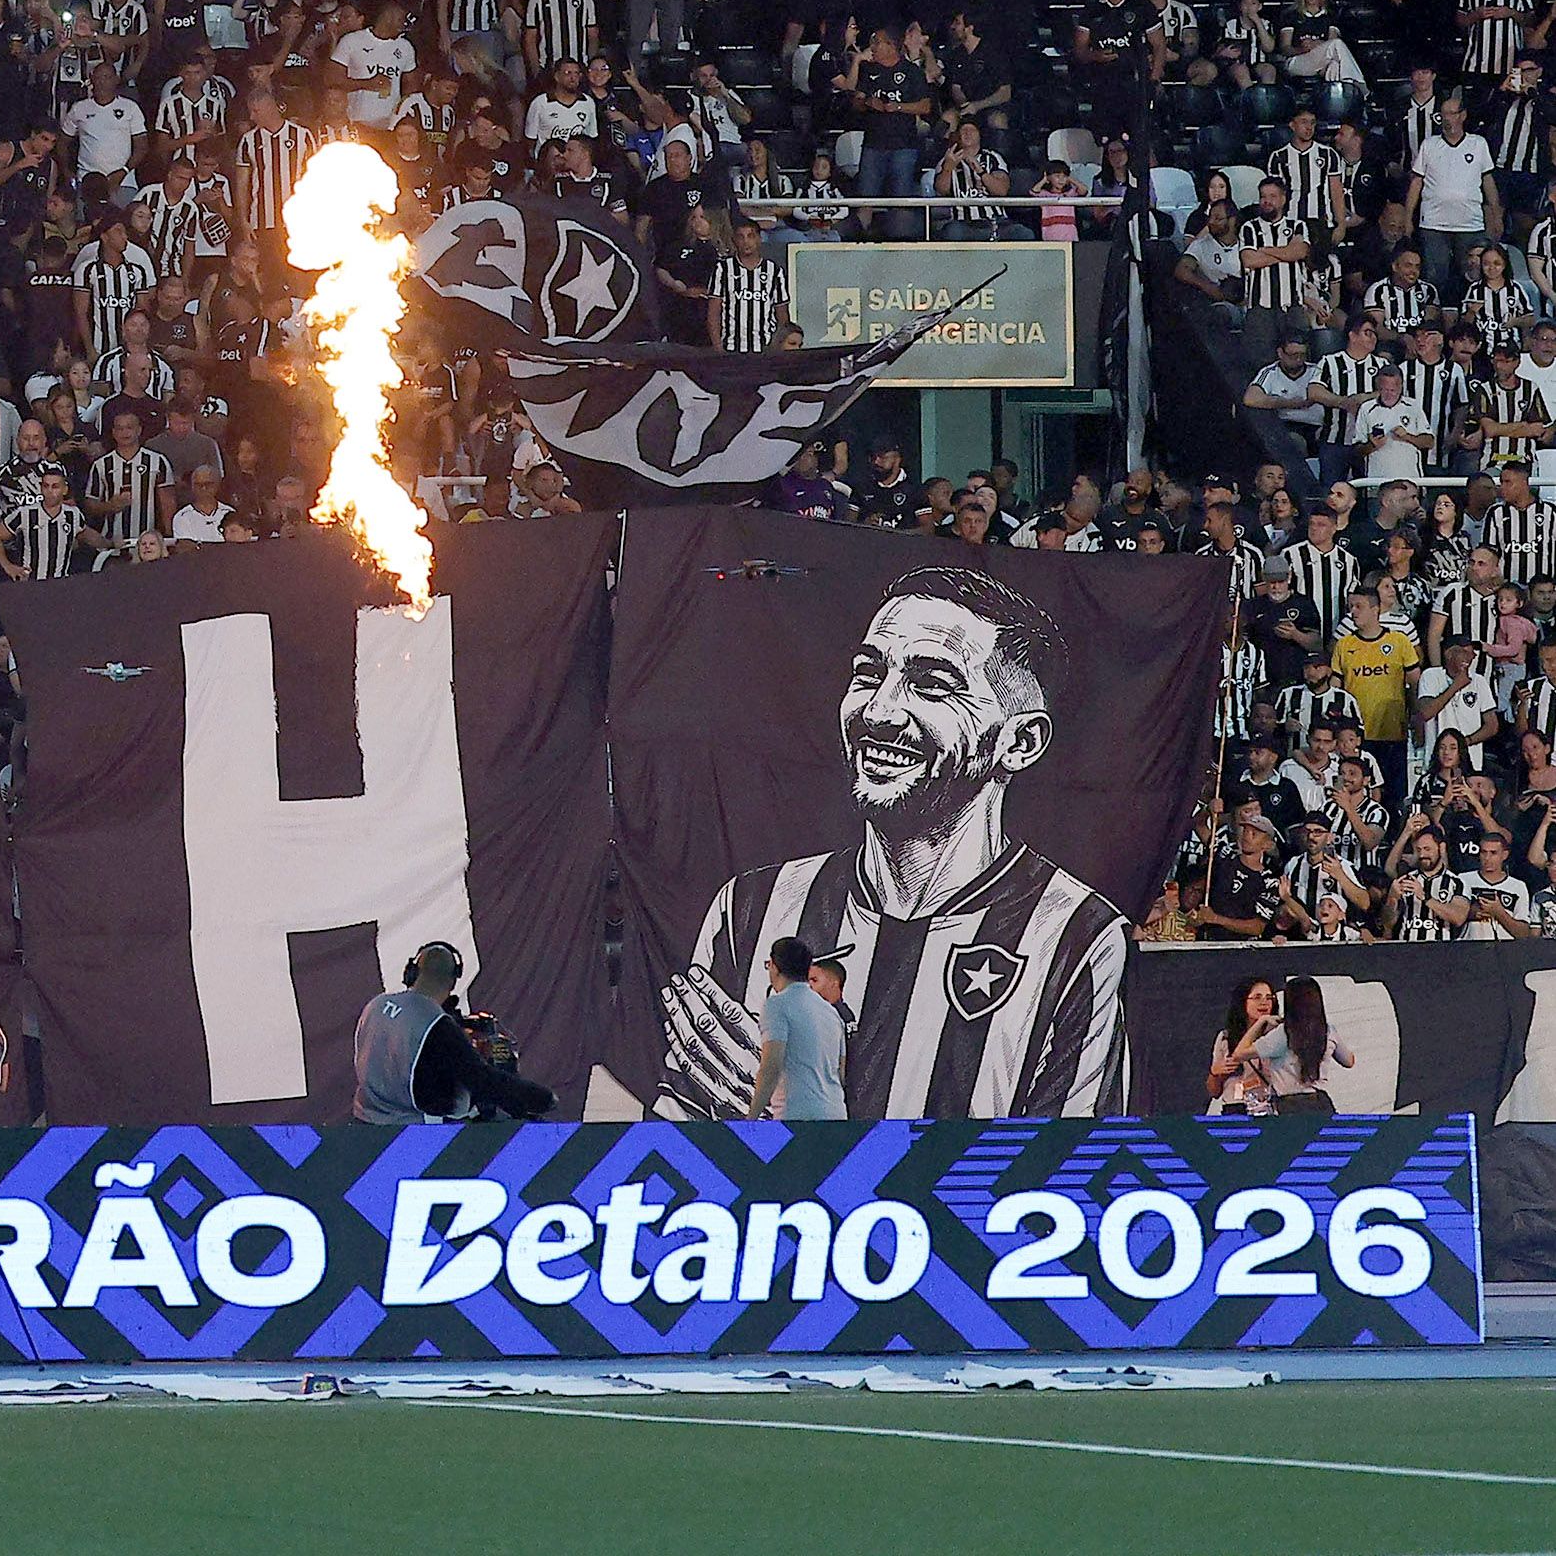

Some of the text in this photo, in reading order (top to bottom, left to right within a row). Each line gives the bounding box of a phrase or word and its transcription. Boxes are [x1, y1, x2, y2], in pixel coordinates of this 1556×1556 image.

[165, 16, 195, 27] vbet
[367, 64, 399, 75] vbet
[31, 275, 70, 285] CAIXA
[736, 289, 767, 300] vbet
[868, 283, 996, 311] SAÍDA DE
[100, 295, 130, 307] vbet
[1392, 316, 1421, 326] vbet
[869, 317, 1047, 345] ERGÊNCIA
[16, 495, 43, 505] vbe
[1115, 537, 1135, 550] vb
[1505, 540, 1538, 553] vbet
[1434, 568, 1459, 578] vbet
[1353, 664, 1388, 676] vbet
[1459, 842, 1479, 853] vb
[382, 1000, 402, 1019] TV
[381, 1177, 1434, 1310] Betano 2026
